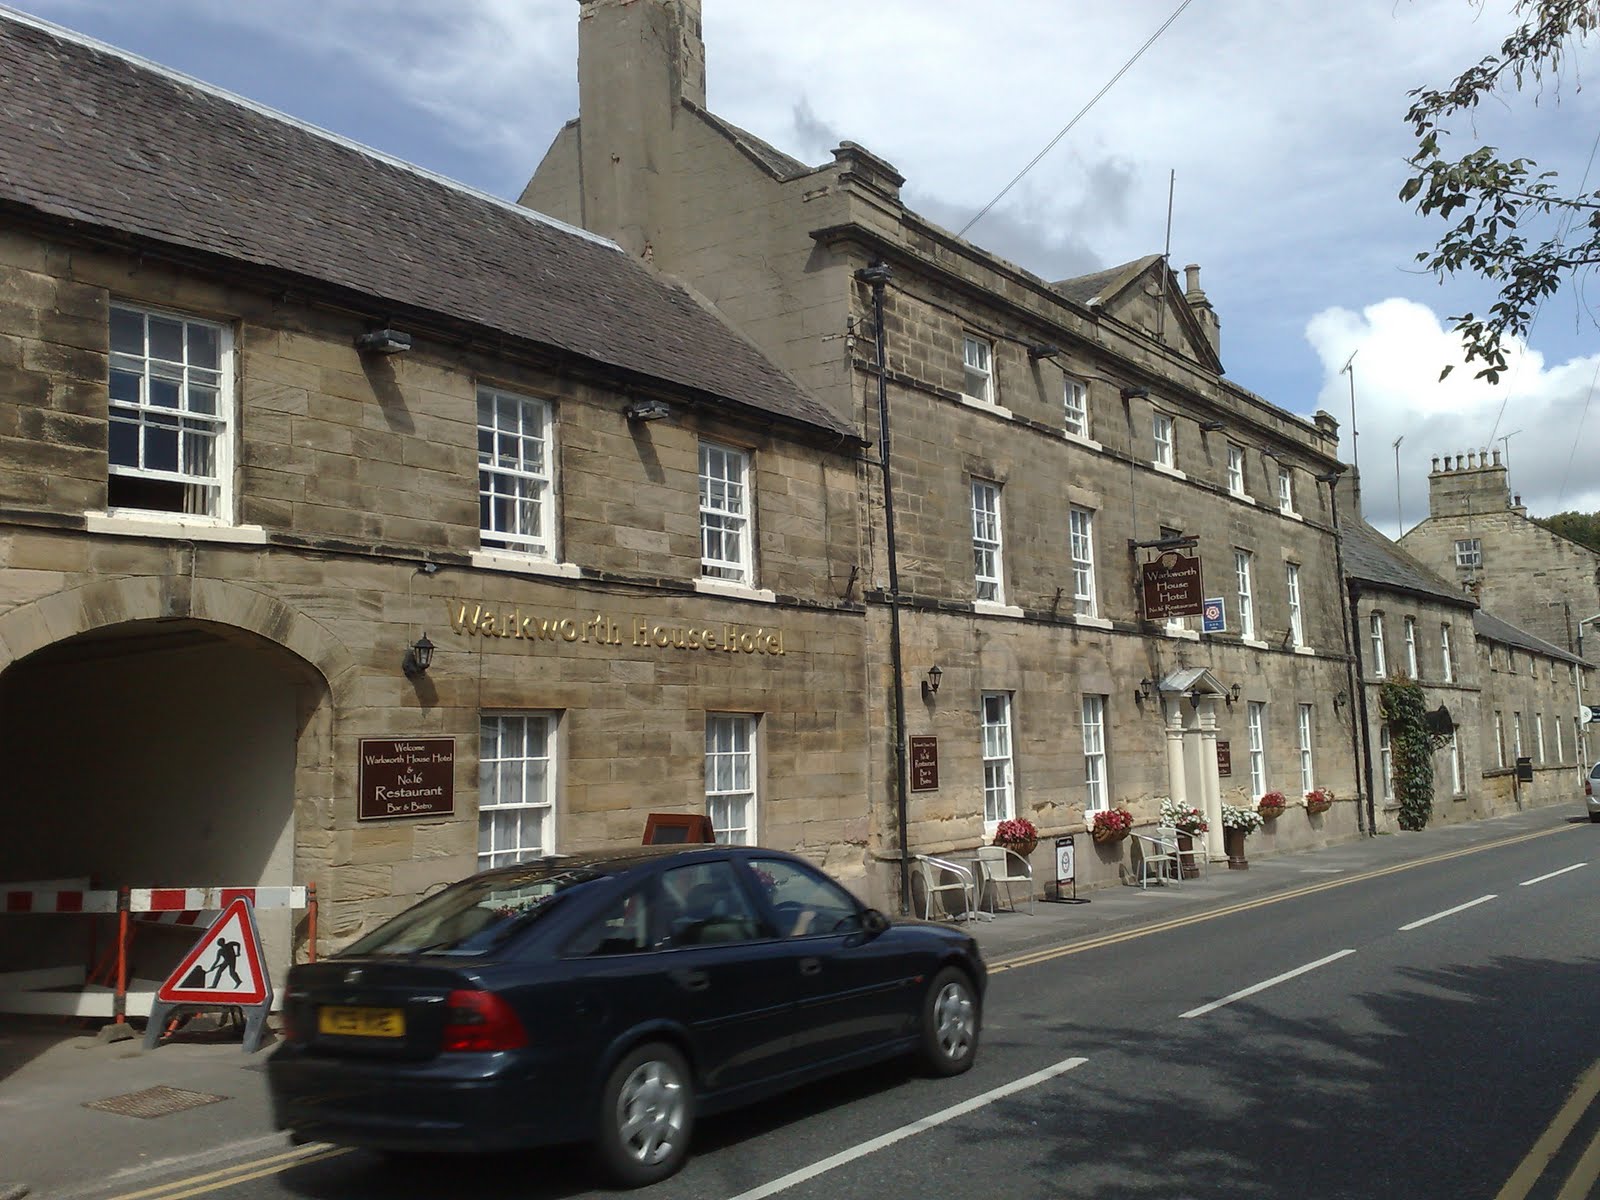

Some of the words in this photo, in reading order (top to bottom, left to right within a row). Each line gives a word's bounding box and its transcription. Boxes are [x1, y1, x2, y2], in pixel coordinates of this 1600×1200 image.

[1147, 567, 1197, 581] Warkworth
[1157, 582, 1189, 592] House
[1160, 591, 1188, 602] Hotel
[449, 600, 623, 646] Warkworth
[631, 616, 717, 651] House
[721, 621, 786, 656] Hotel
[394, 743, 425, 752] Welcome
[365, 754, 404, 765] Warkworth
[406, 753, 430, 764] House
[432, 752, 452, 763] Hotel
[407, 766, 413, 774] &
[375, 785, 443, 801] Restaurant
[387, 803, 401, 813] Bar
